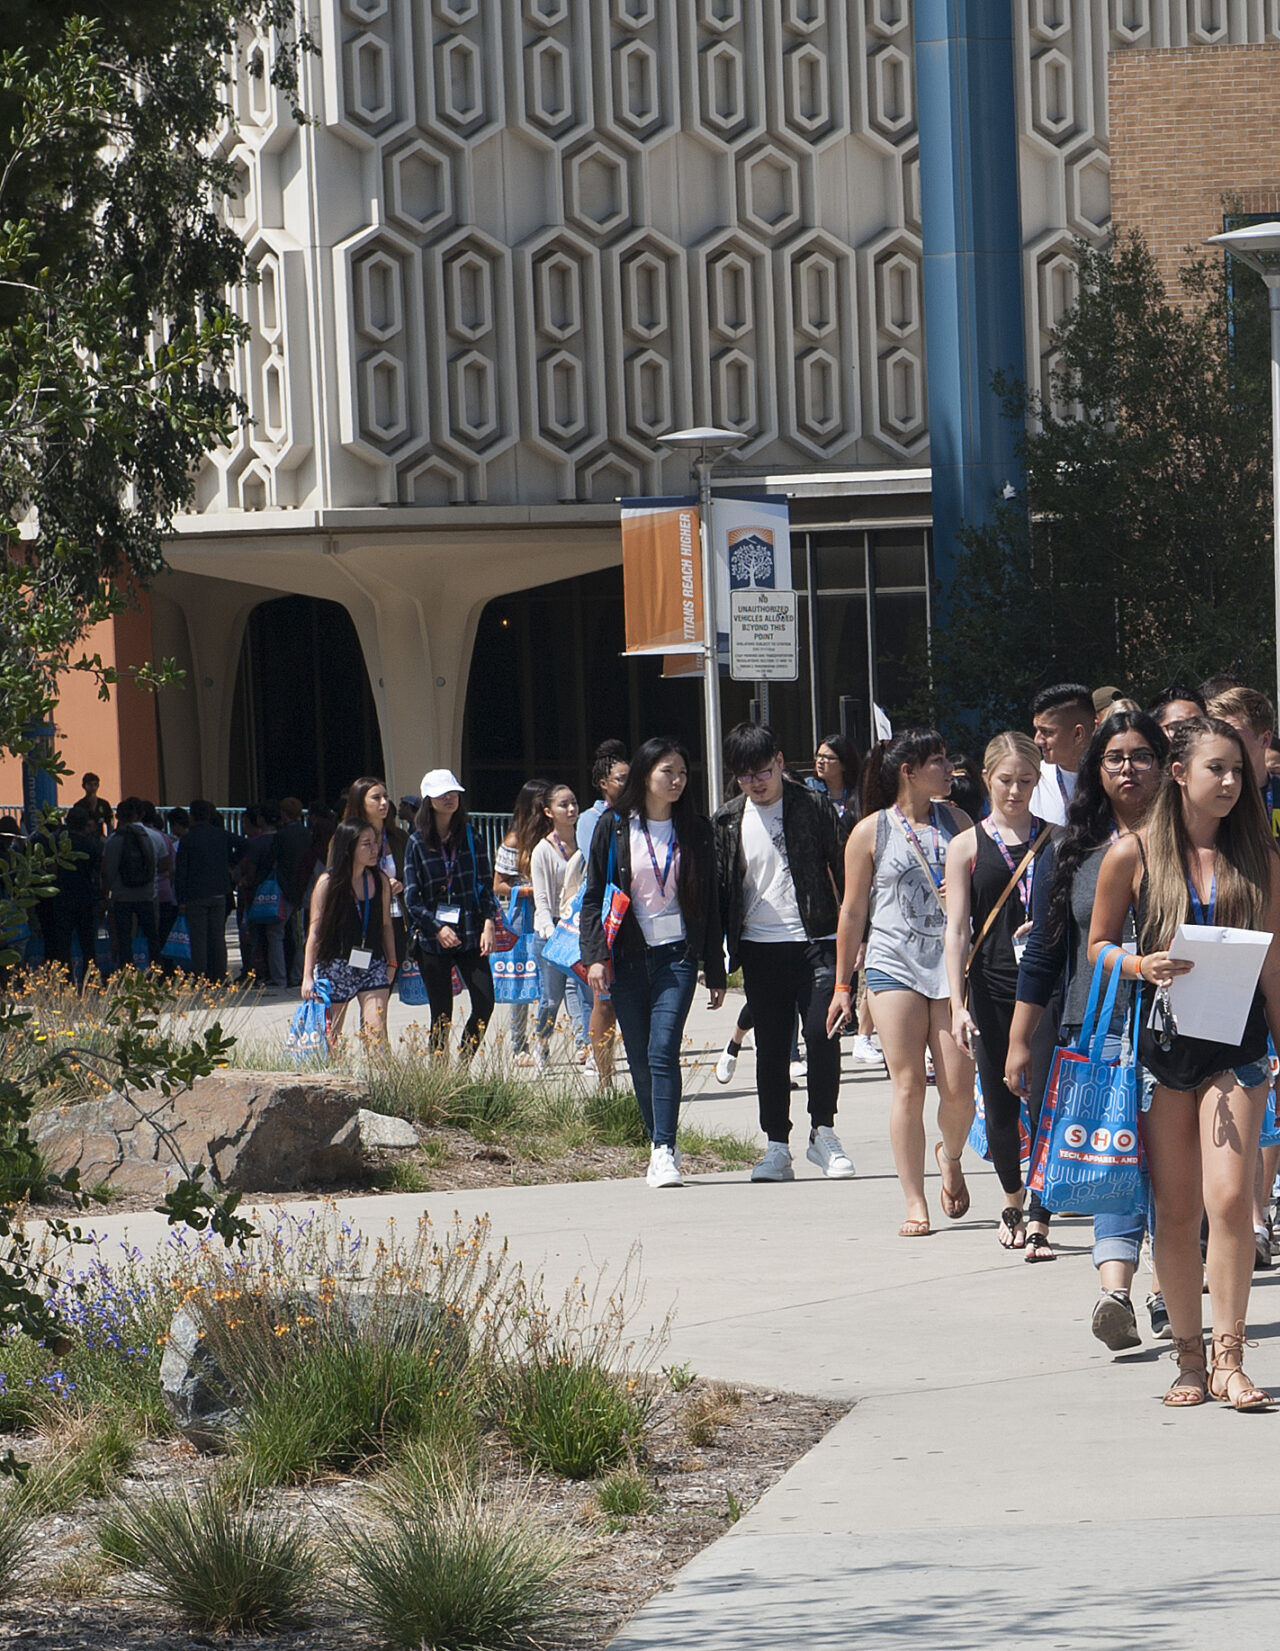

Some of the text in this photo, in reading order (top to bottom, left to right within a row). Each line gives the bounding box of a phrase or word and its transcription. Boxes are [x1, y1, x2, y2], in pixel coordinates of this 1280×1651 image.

[679, 513, 695, 640] TITANS REACH HIGHER
[738, 605, 789, 613] UNAUTHORIZED
[889, 847, 946, 873] HAPP
[1059, 1149, 1082, 1160] TECH,
[1084, 1153, 1118, 1164] APPAREL,
